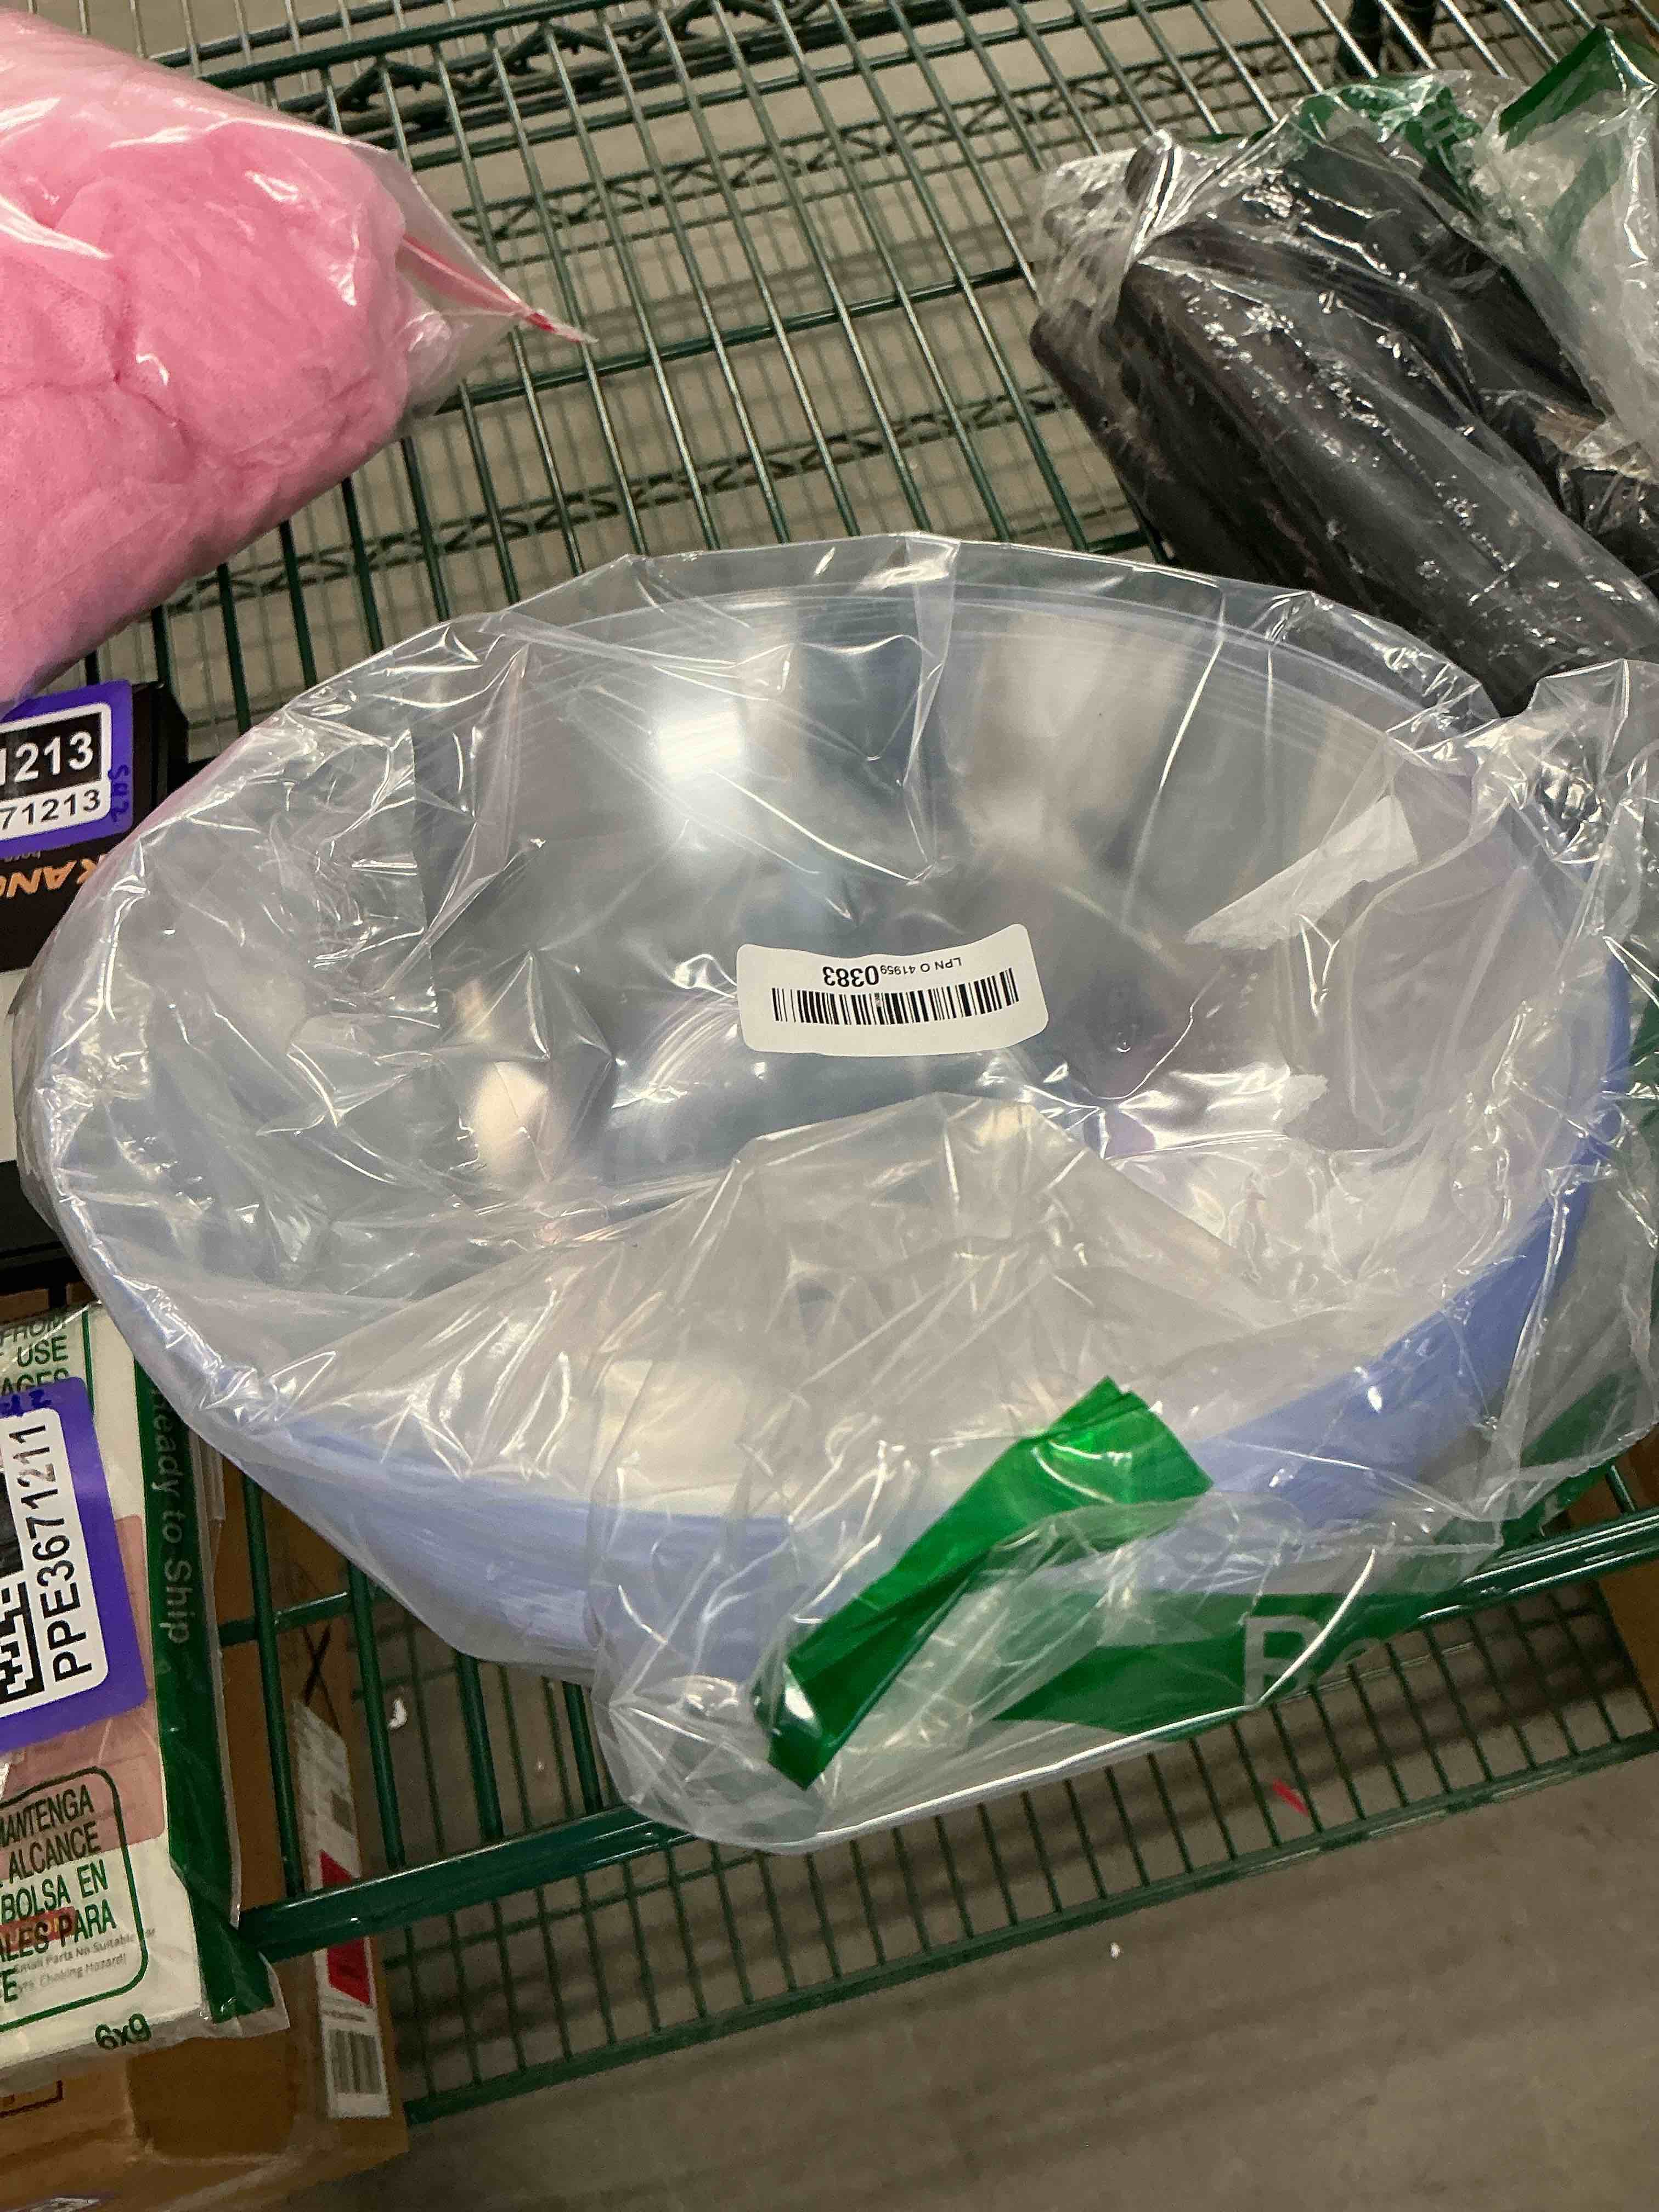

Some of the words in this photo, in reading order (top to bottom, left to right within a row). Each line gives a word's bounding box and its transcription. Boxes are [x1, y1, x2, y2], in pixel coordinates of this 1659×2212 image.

[0, 789, 100, 830] 71213
[934, 957, 962, 971] LPN
[17, 1335, 69, 1368] USE
[162, 1509, 186, 1544] to
[8, 1425, 93, 1682] PPE3671211
[159, 1559, 197, 1644] Ship
[8, 1820, 101, 1884] ALCANCE
[1, 1874, 71, 1922] BOLSA
[77, 1859, 109, 1898] EN
[59, 1899, 117, 1948] PARA
[94, 2013, 151, 2050] 6x9
